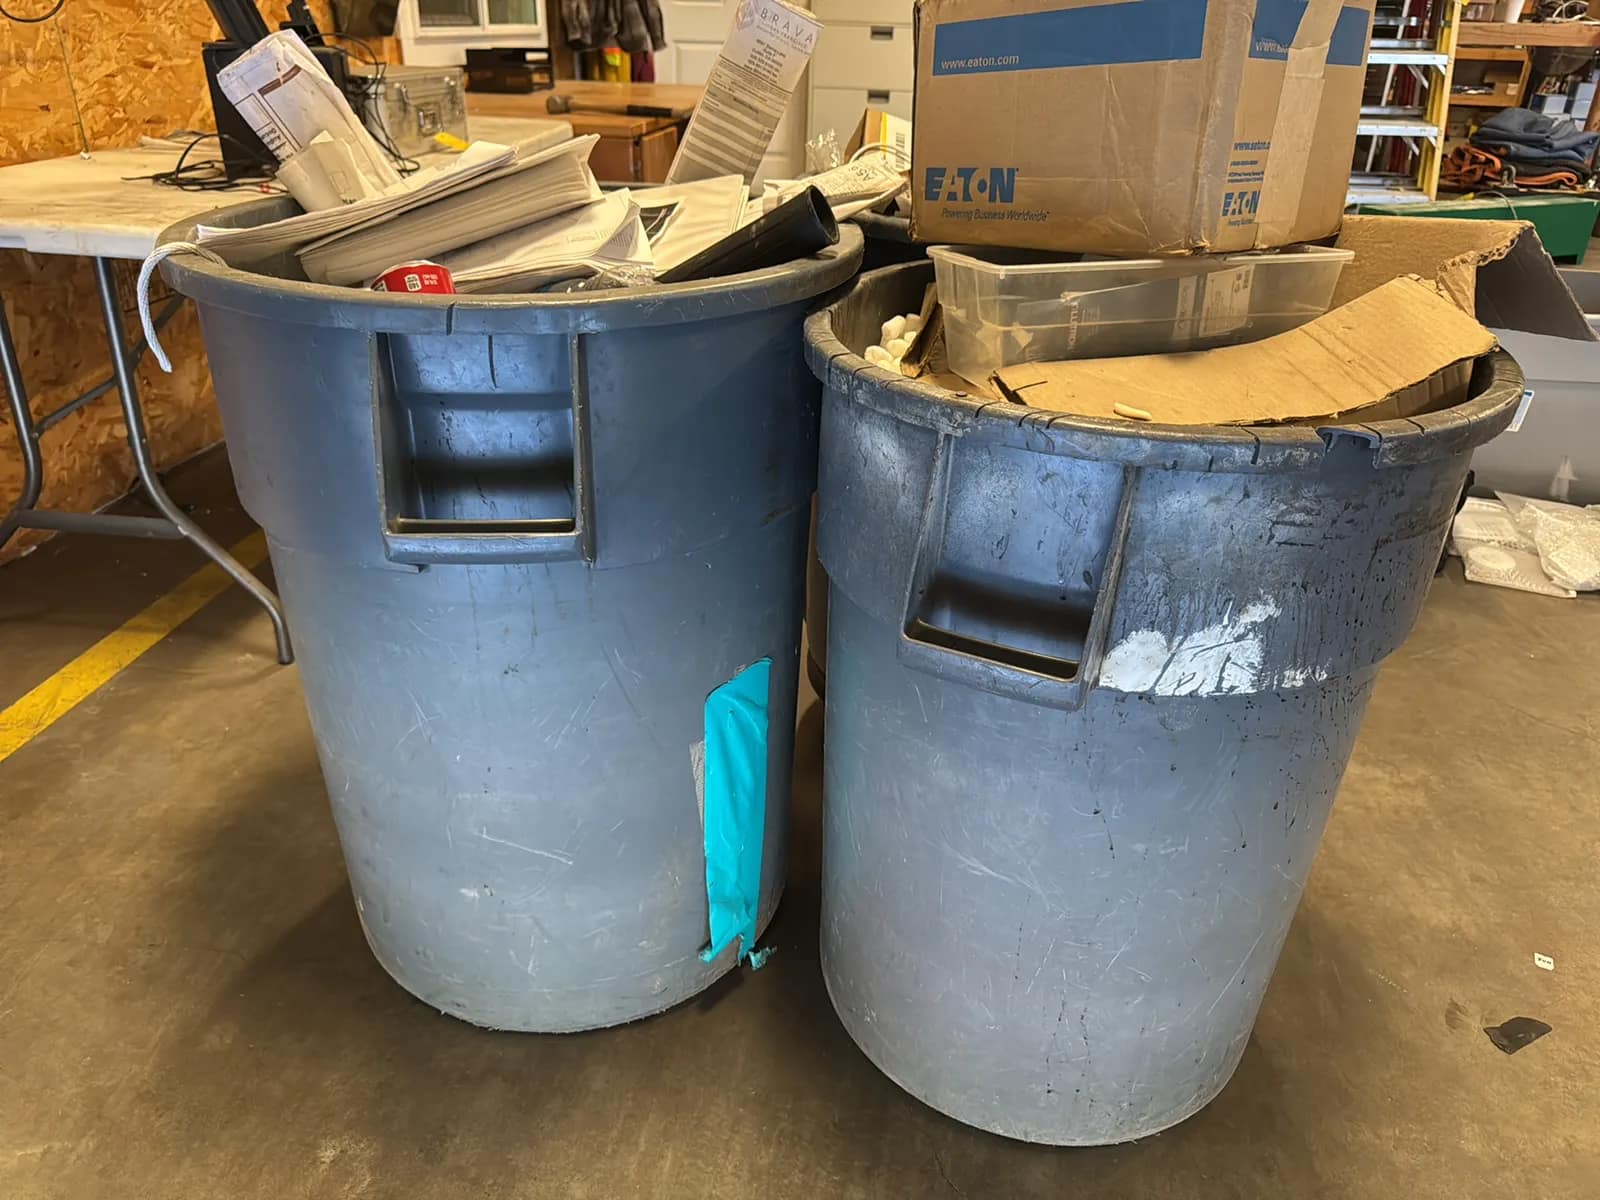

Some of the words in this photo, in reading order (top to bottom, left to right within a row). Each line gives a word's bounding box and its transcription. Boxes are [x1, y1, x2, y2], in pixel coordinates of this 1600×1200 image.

[760, 8, 813, 43] BRAVA
[941, 55, 1019, 69] www.eaton.com
[925, 167, 1015, 204] EATON
[943, 208, 973, 222] Powering
[974, 208, 1005, 222] Business
